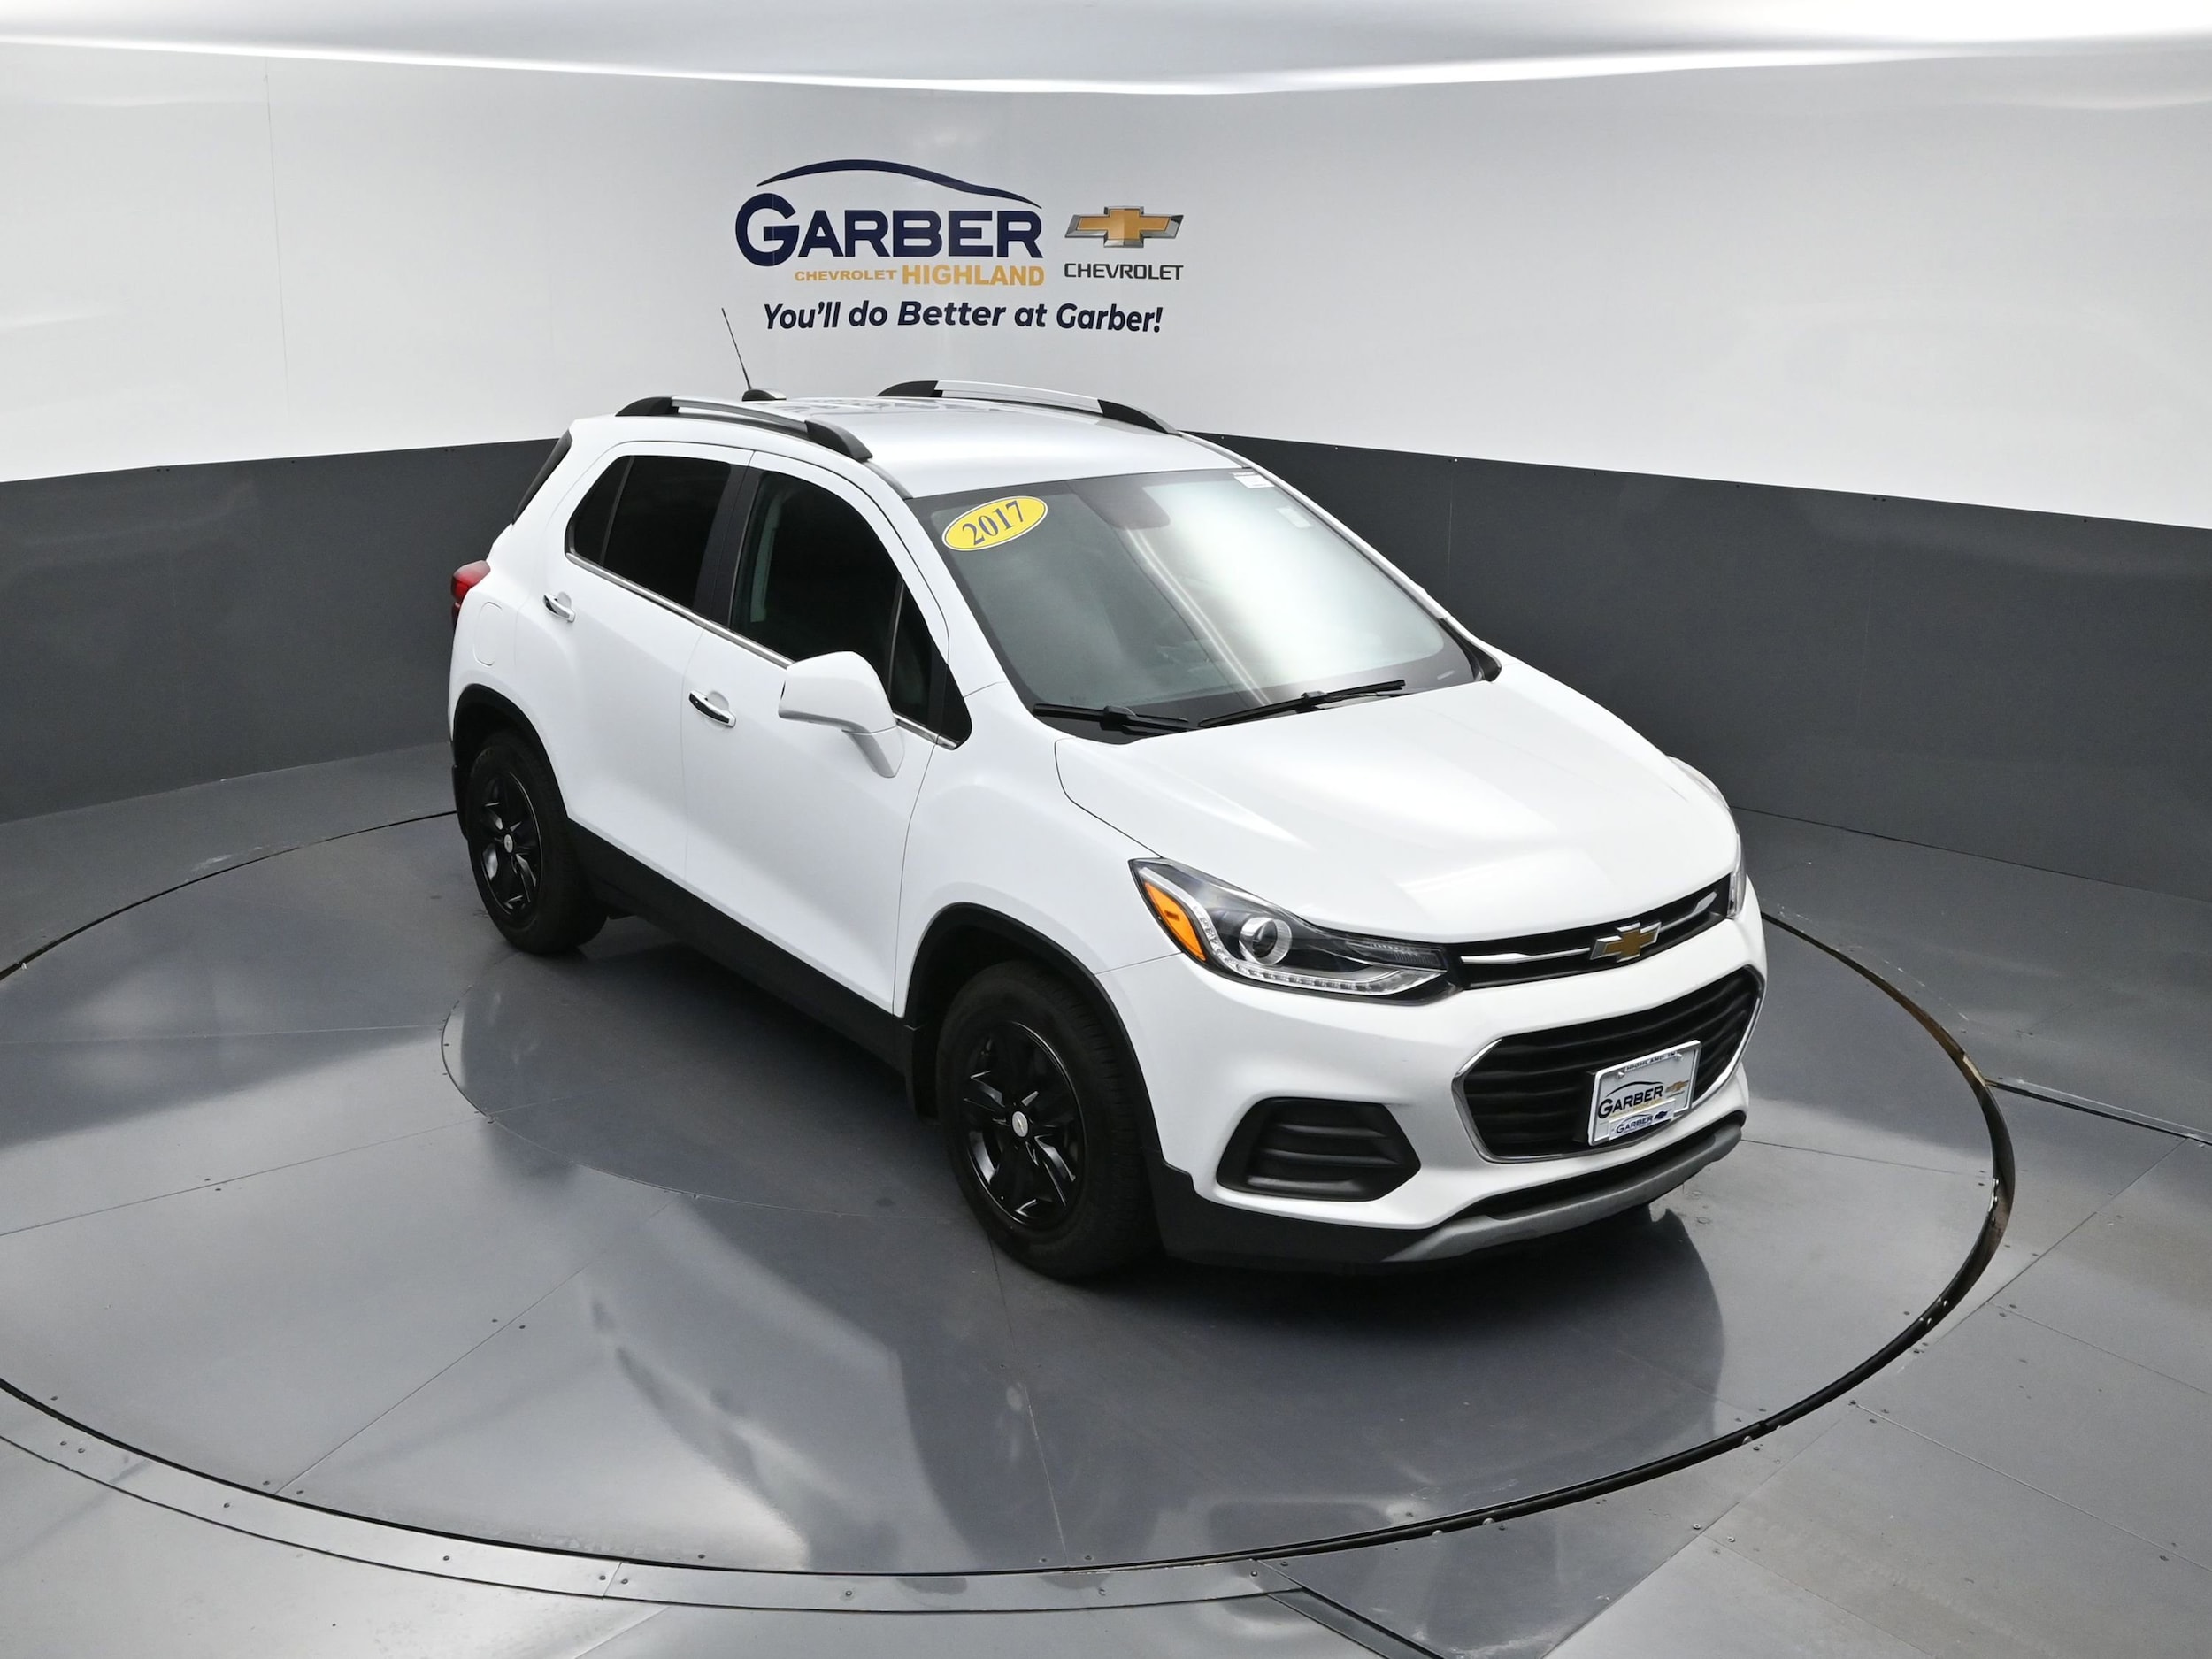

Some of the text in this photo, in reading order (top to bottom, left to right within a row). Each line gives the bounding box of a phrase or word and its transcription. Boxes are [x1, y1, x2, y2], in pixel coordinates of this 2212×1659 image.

[735, 193, 1043, 267] GARBER
[795, 265, 1045, 287] CHEVROLET HIGHLAND
[1064, 263, 1184, 280] CHEVROLET
[764, 300, 1164, 334] You'll do Better at Garber!
[962, 500, 1024, 545] 2017
[1598, 1085, 1663, 1118] GARBER
[1616, 1115, 1653, 1133] GARBER
